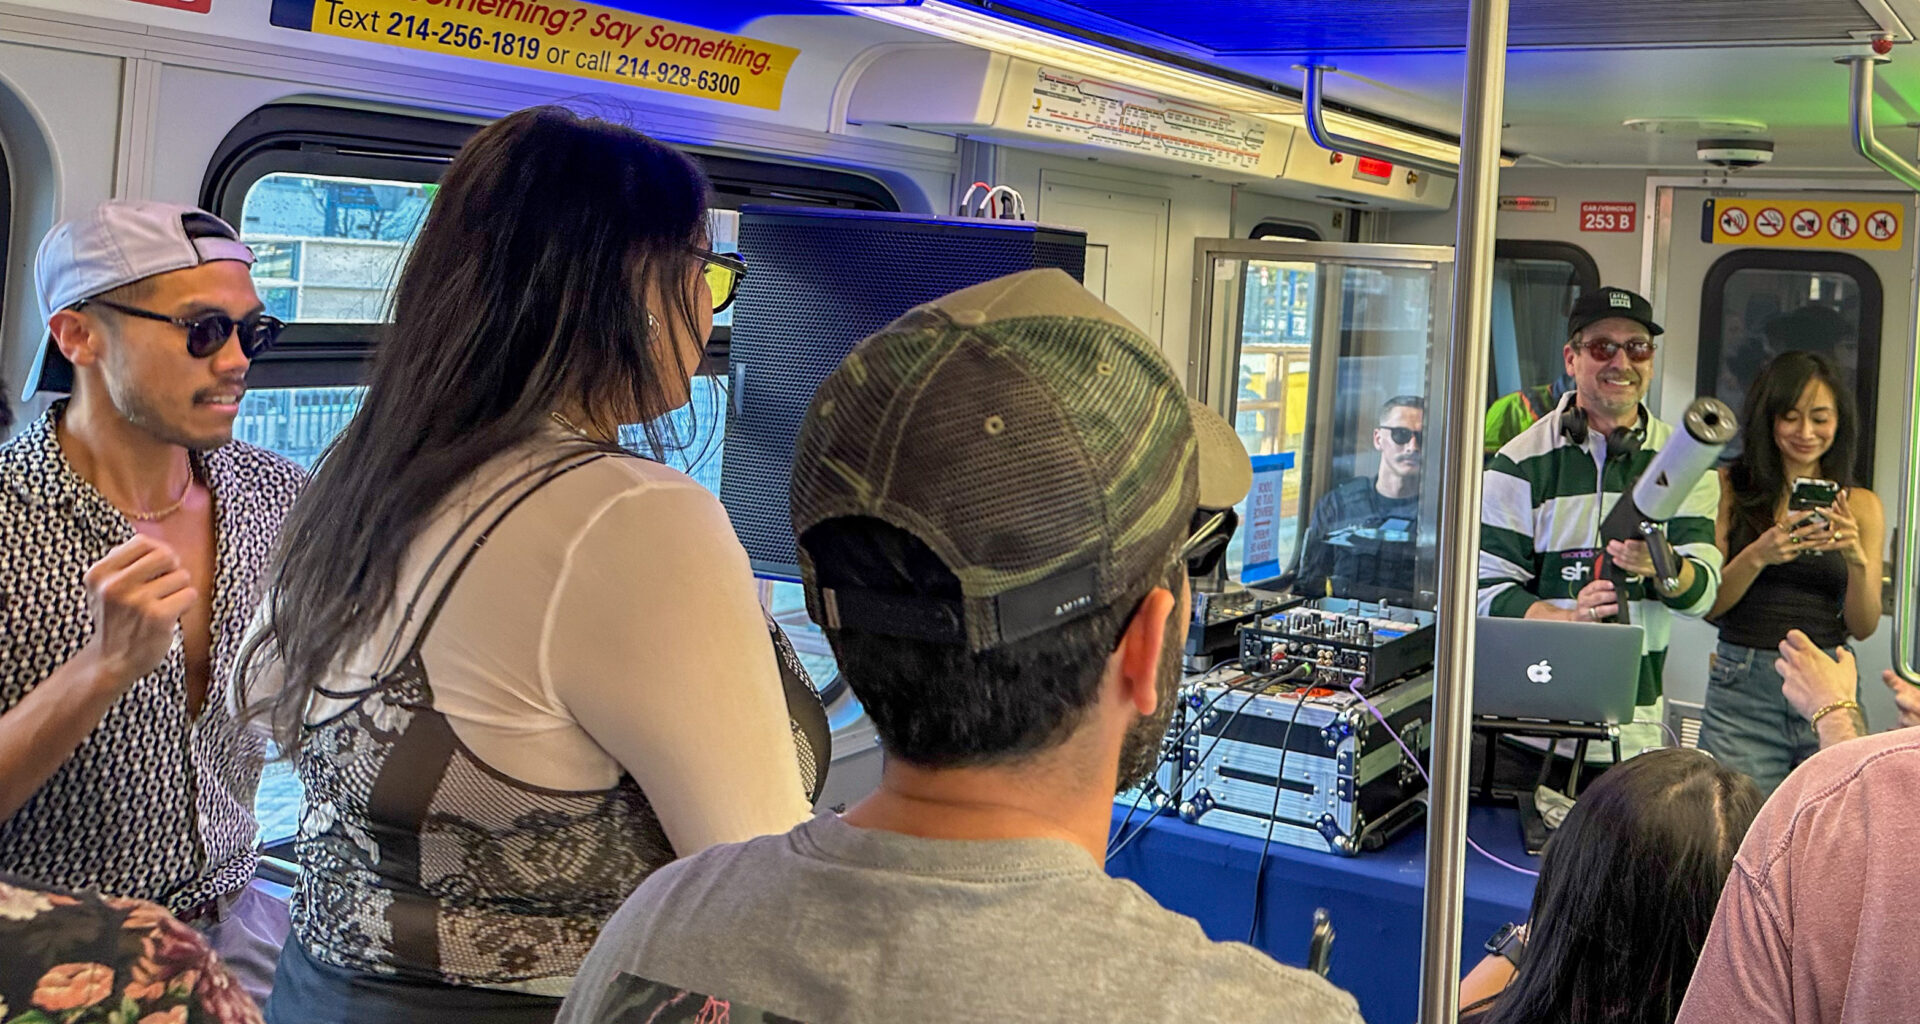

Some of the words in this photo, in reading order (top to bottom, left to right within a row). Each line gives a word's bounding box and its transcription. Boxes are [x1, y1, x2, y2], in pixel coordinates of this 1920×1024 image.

[325, 0, 380, 33] Text
[386, 12, 541, 60] 214-256-1819
[547, 47, 570, 65] or
[575, 50, 612, 73] call
[615, 54, 741, 96] 214-928-6300
[411, 0, 588, 36] ething?
[590, 13, 643, 49] Say
[645, 25, 772, 76] Something.
[1585, 213, 1615, 229] 253
[1620, 214, 1630, 229] B
[1055, 594, 1091, 616] AMIRI
